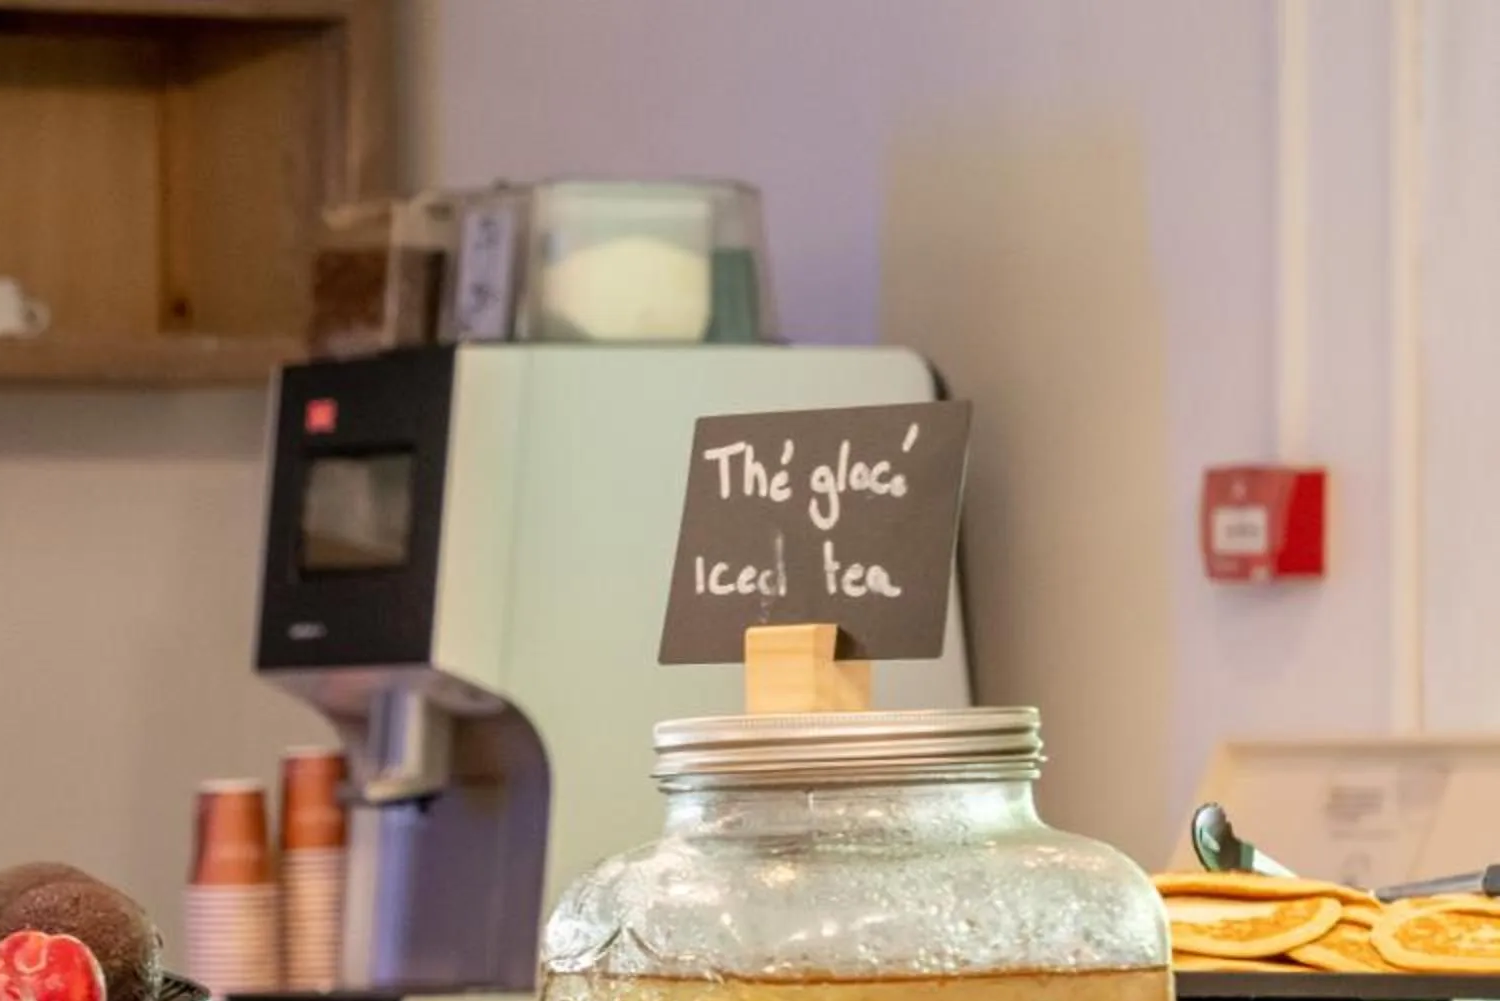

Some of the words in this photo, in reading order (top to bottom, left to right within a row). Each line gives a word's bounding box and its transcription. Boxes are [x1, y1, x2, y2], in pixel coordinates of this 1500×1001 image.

[703, 438, 794, 502] Thé
[695, 529, 787, 597] Iced
[823, 539, 902, 598] tea
